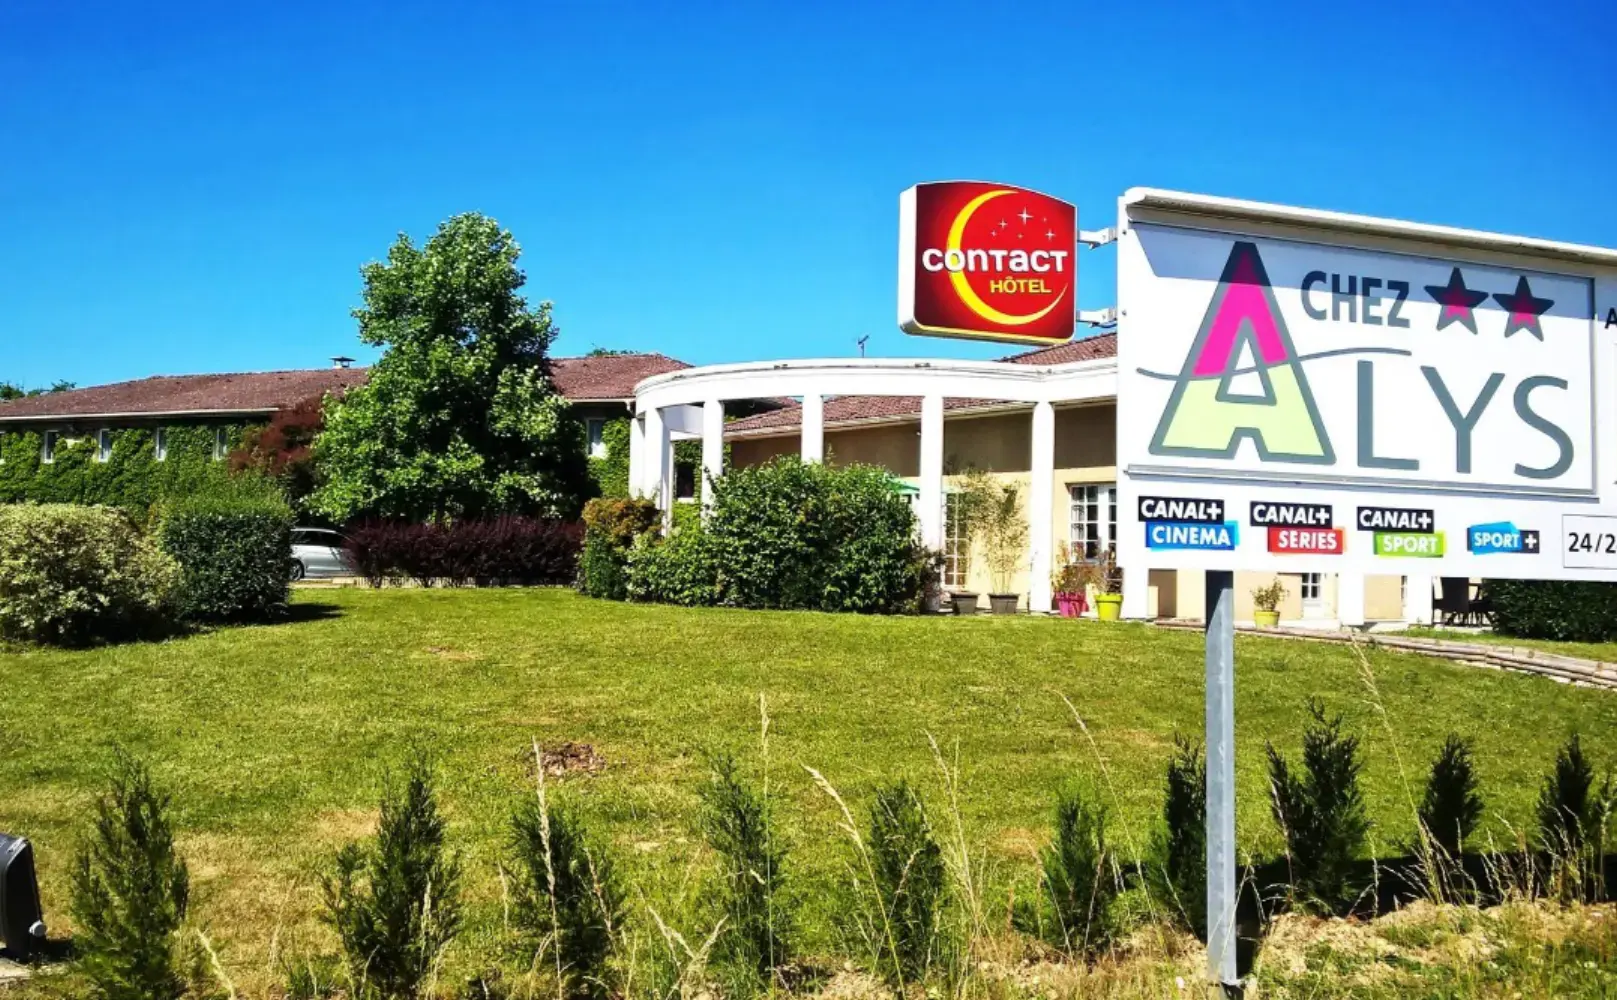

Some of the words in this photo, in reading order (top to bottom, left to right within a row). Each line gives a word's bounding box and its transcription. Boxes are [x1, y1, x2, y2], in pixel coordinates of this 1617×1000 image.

[989, 276, 1052, 294] HÔTEL
[1300, 270, 1411, 329] CHEZ
[1140, 499, 1221, 520] CANAL+
[1252, 504, 1330, 524] CANAL+
[1359, 509, 1431, 529] CANAL+
[1383, 534, 1437, 553] SPORT
[1568, 532, 1617, 554] 24/2
